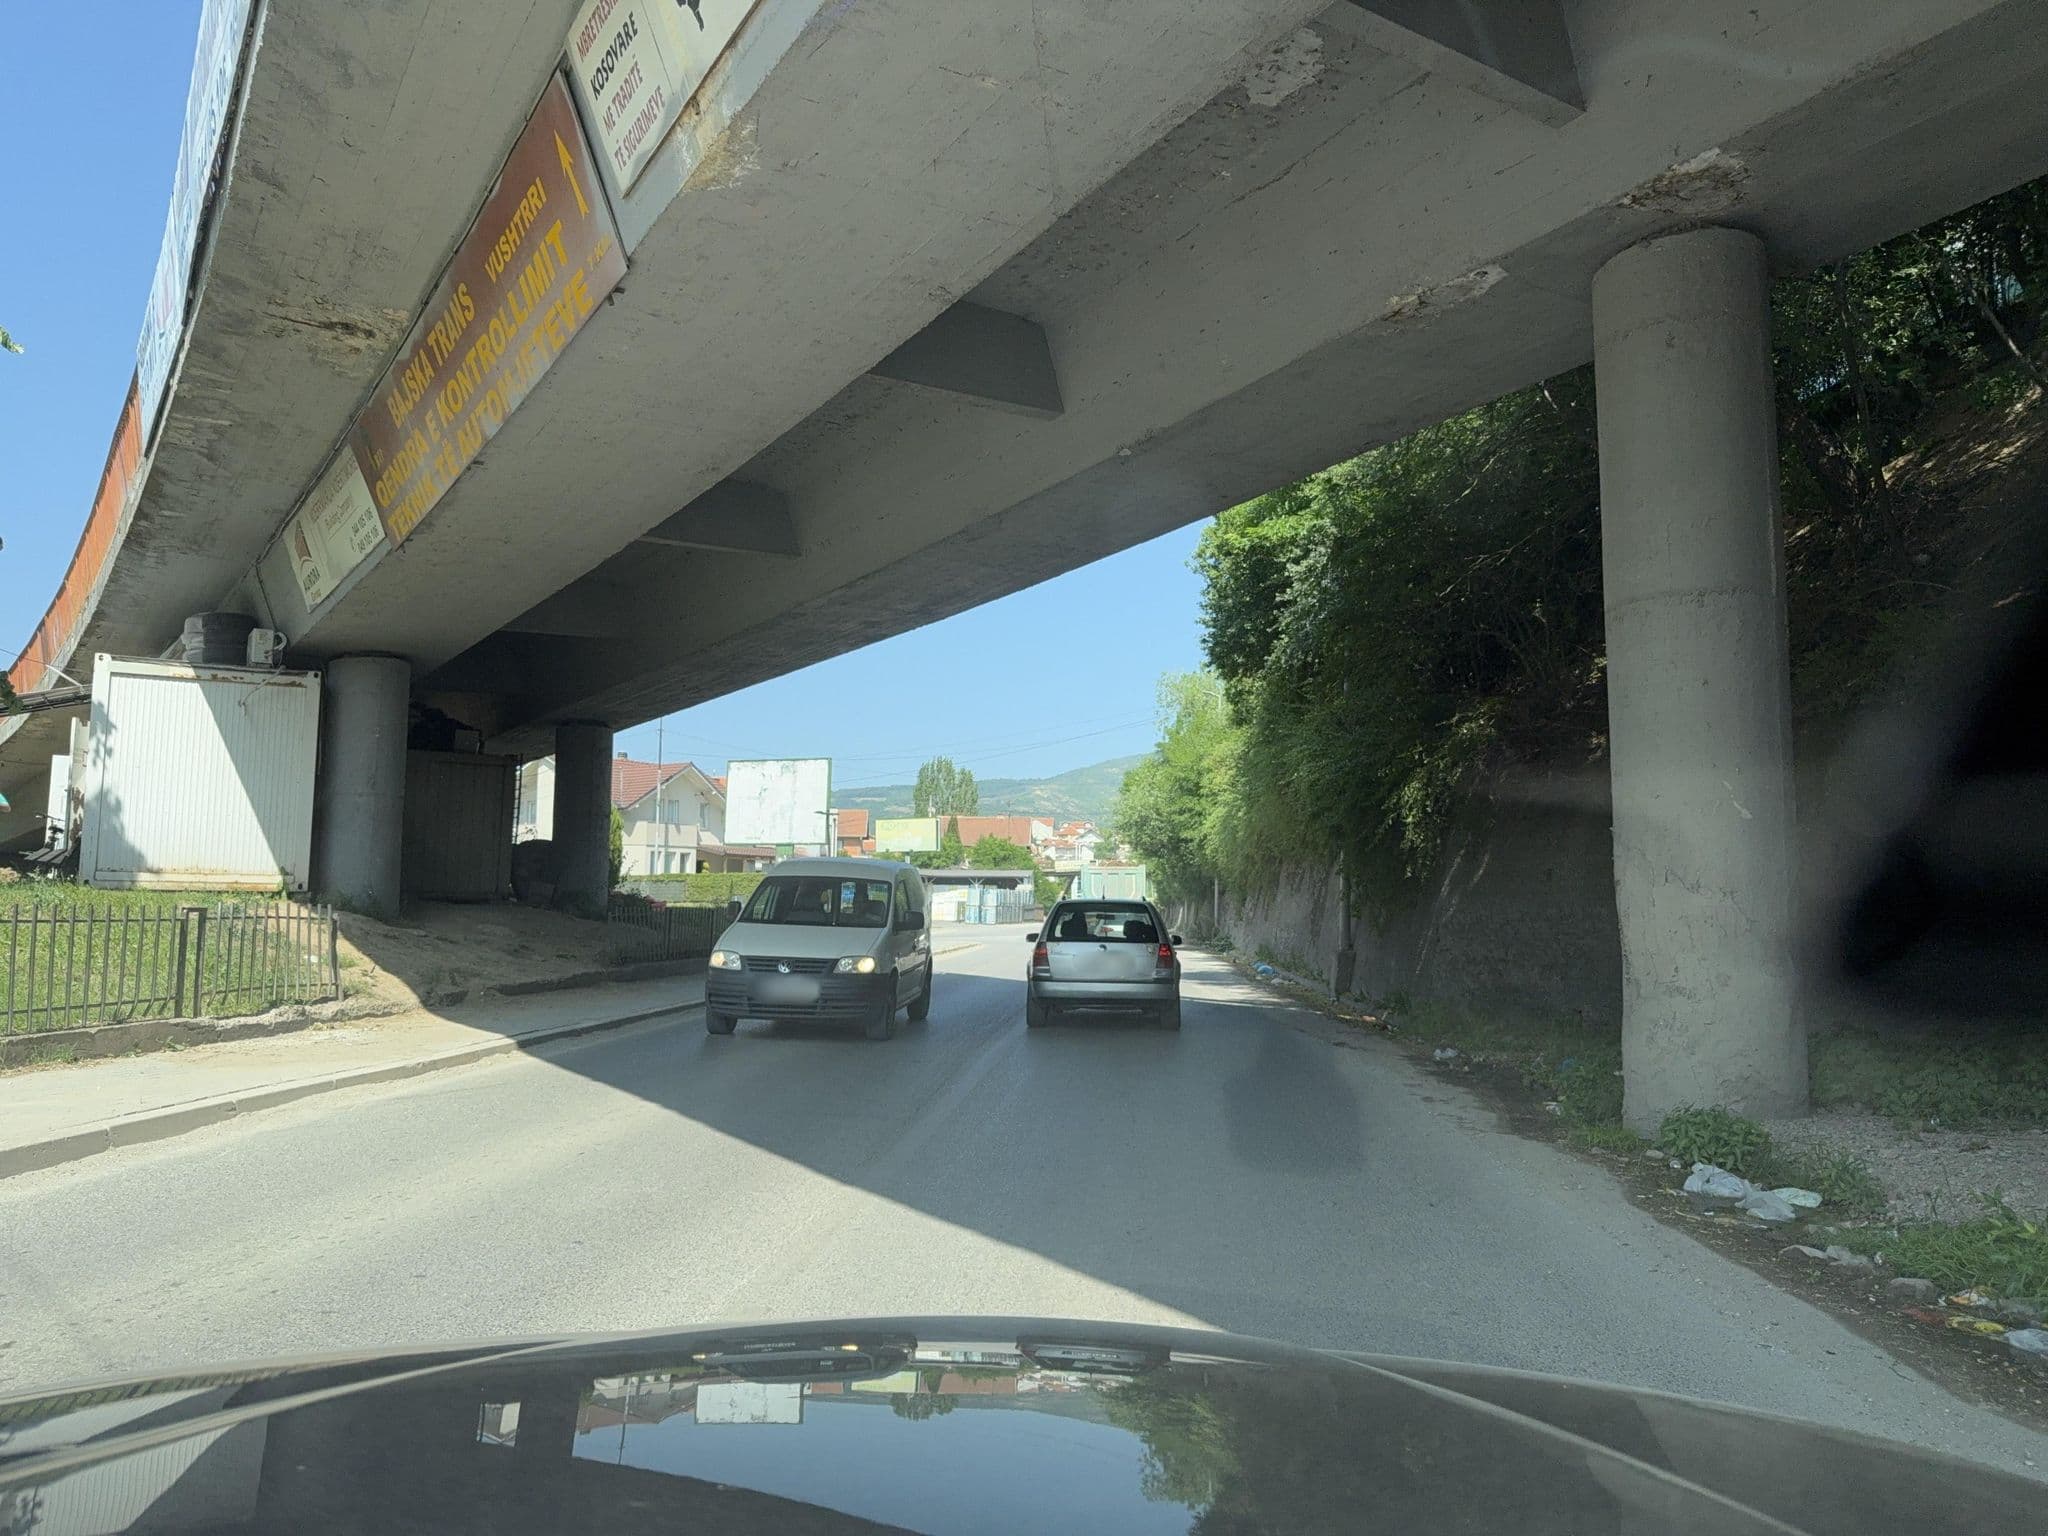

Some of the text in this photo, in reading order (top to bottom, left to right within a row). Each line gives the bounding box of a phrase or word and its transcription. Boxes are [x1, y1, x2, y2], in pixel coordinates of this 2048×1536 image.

[589, 11, 639, 101] KOSOVARE
[602, 113, 616, 137] ME
[622, 84, 666, 163] SIGURIMEVE
[484, 176, 547, 283] VUSHTRRI
[424, 409, 441, 443] E
[434, 219, 569, 428] KONTROLLIMIT
[426, 282, 476, 366] TRANS
